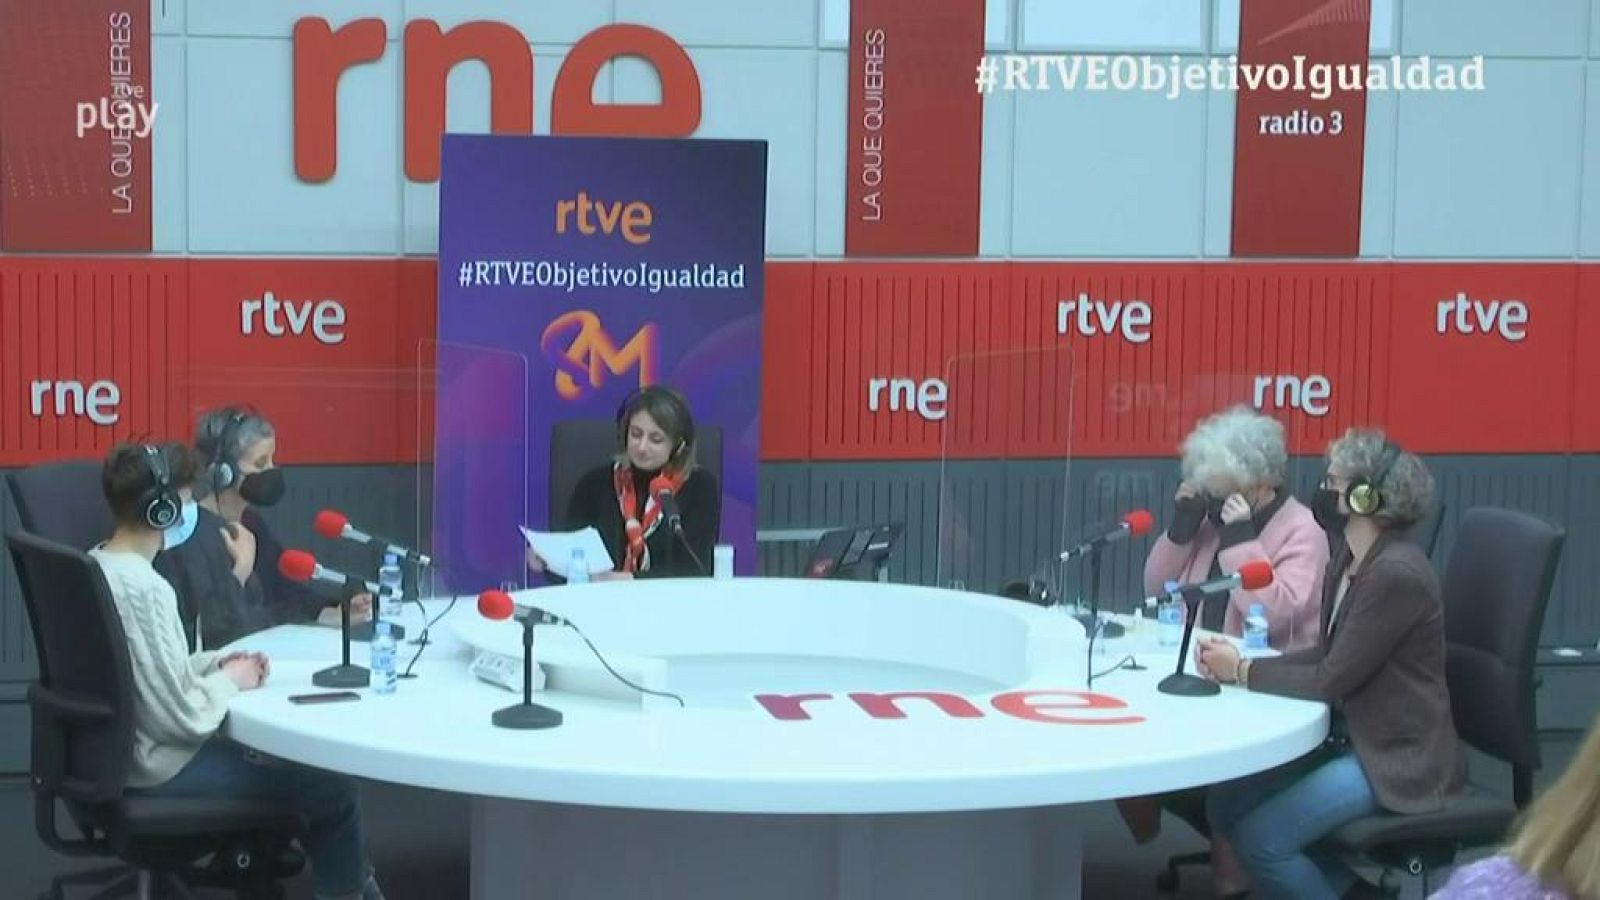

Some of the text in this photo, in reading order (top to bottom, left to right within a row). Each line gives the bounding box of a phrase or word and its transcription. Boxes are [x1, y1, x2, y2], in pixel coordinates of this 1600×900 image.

[109, 11, 132, 214] LA QUE QUIERES
[293, 16, 702, 184] rne
[862, 28, 885, 221] LA QUE QUIERES
[555, 191, 653, 244] rtve
[458, 260, 746, 293] #RTVEObjetivoIgualdad
[240, 291, 347, 344] rtve
[1057, 293, 1152, 343] rtve
[1436, 292, 1529, 341] rtve
[30, 377, 120, 425] rne
[868, 375, 948, 420] rne
[1253, 373, 1331, 416] rne
[753, 690, 1147, 726] rne
